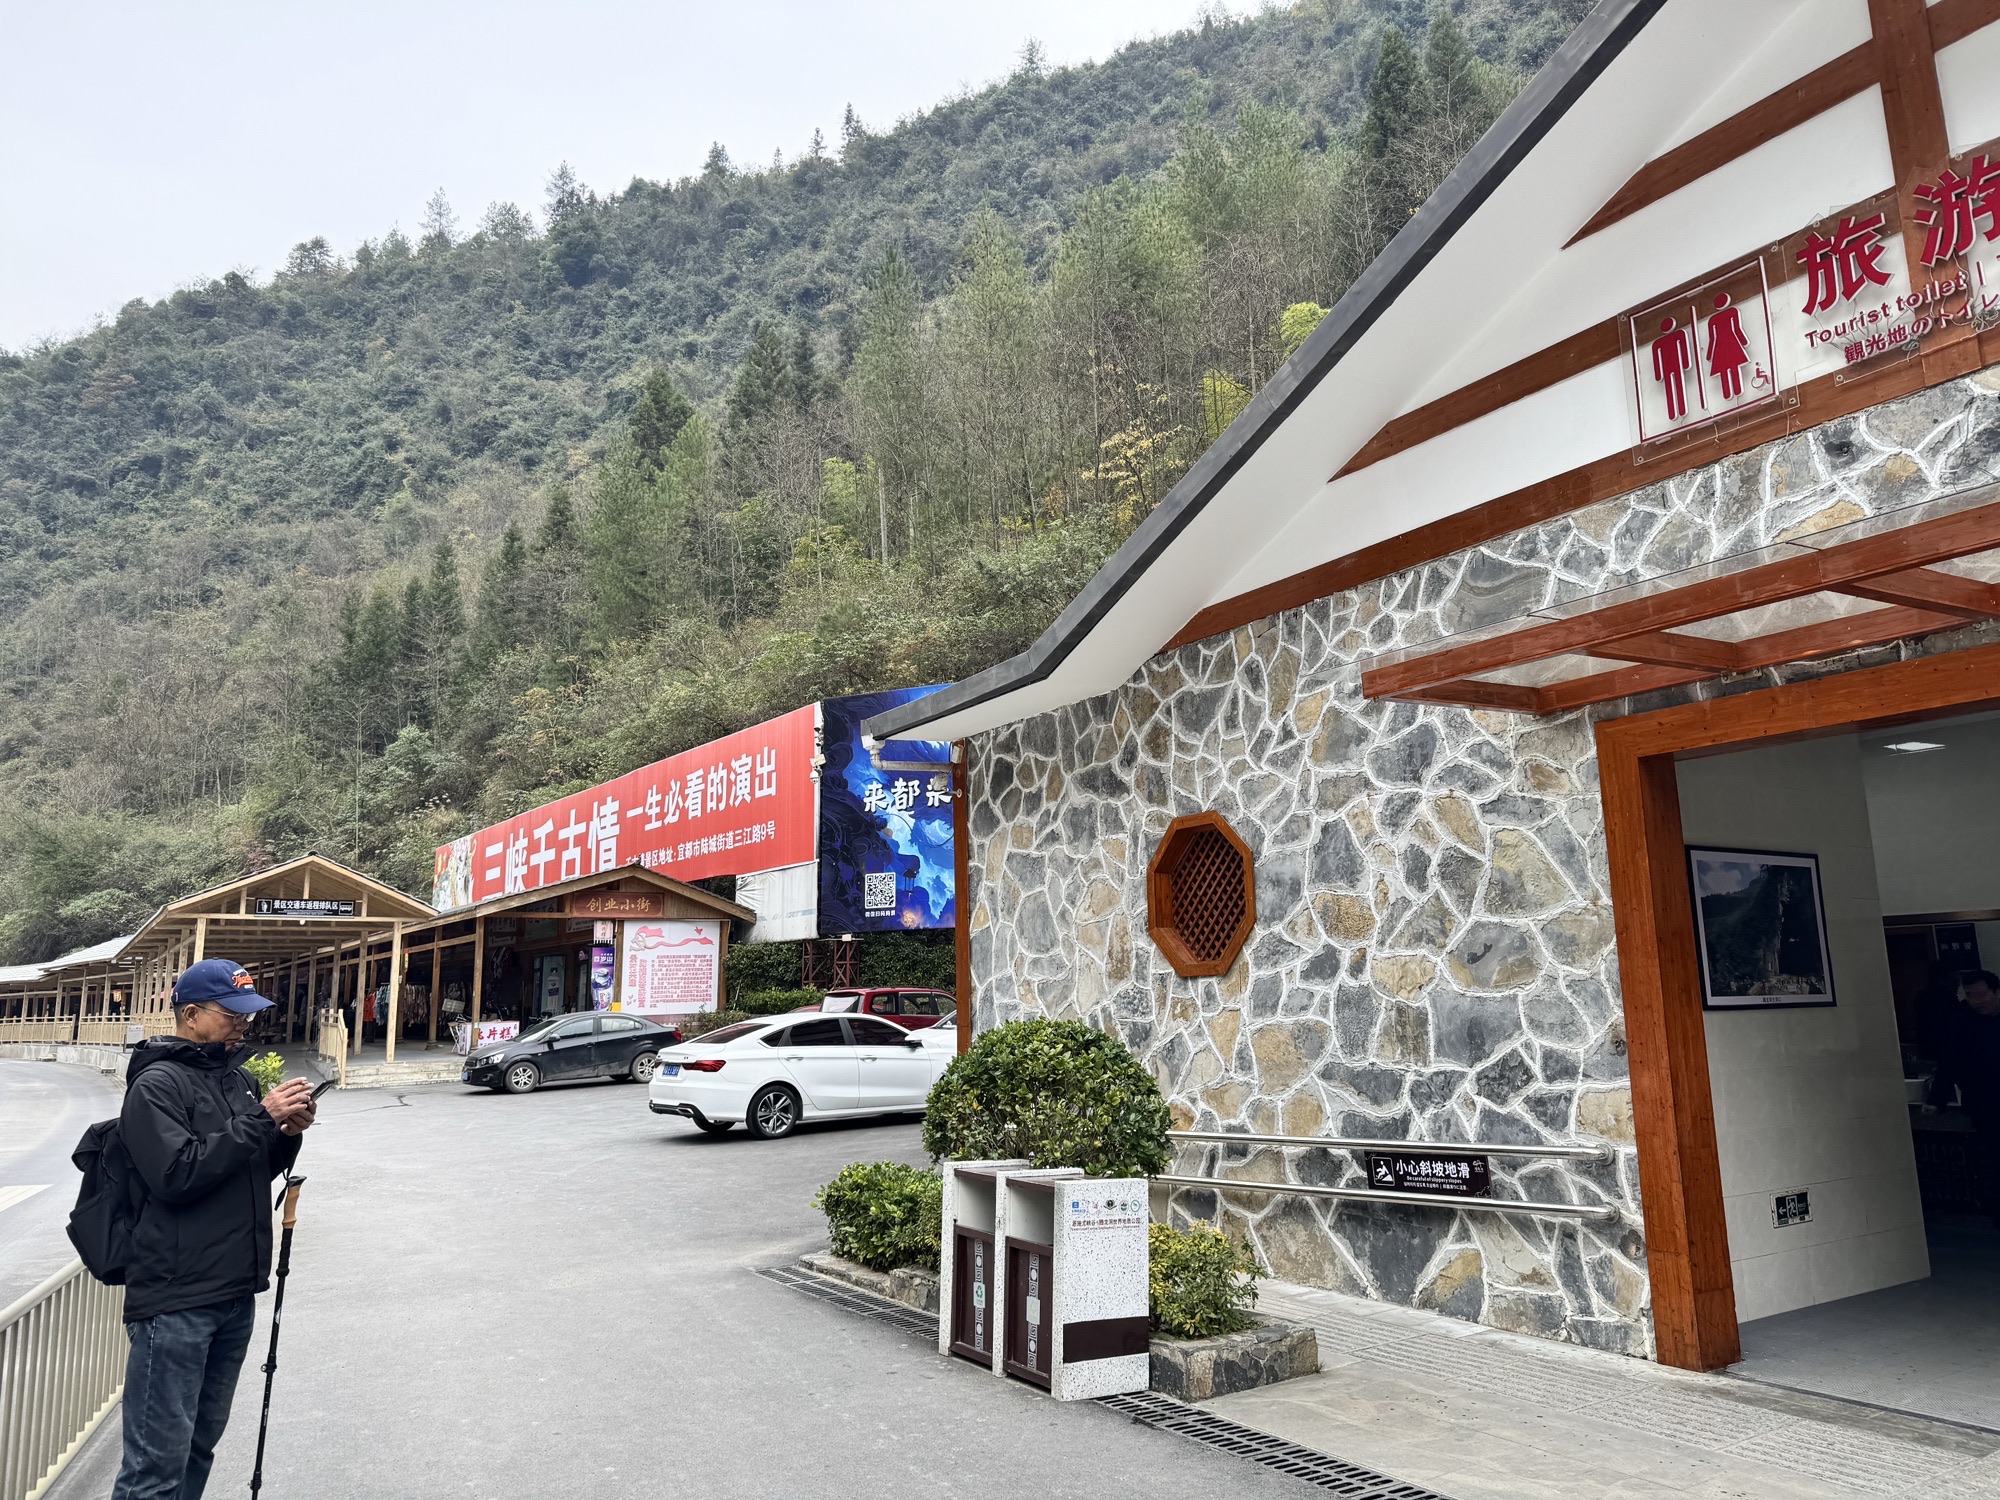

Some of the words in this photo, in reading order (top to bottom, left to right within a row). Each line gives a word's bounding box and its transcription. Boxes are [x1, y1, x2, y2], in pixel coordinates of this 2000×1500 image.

[1805, 301, 1893, 347] Tourist
[1896, 271, 1968, 311] toilet
[1844, 292, 2000, 364] 観光地のトイレ
[626, 746, 777, 832] 一生必看的演出
[481, 796, 620, 900] 三峡千古情
[273, 900, 339, 910] 景区交通车返程排队区
[586, 897, 651, 912] 创业小街
[1396, 1159, 1470, 1179] 小心斜坡地滑
[1431, 1176, 1448, 1184] slippery
